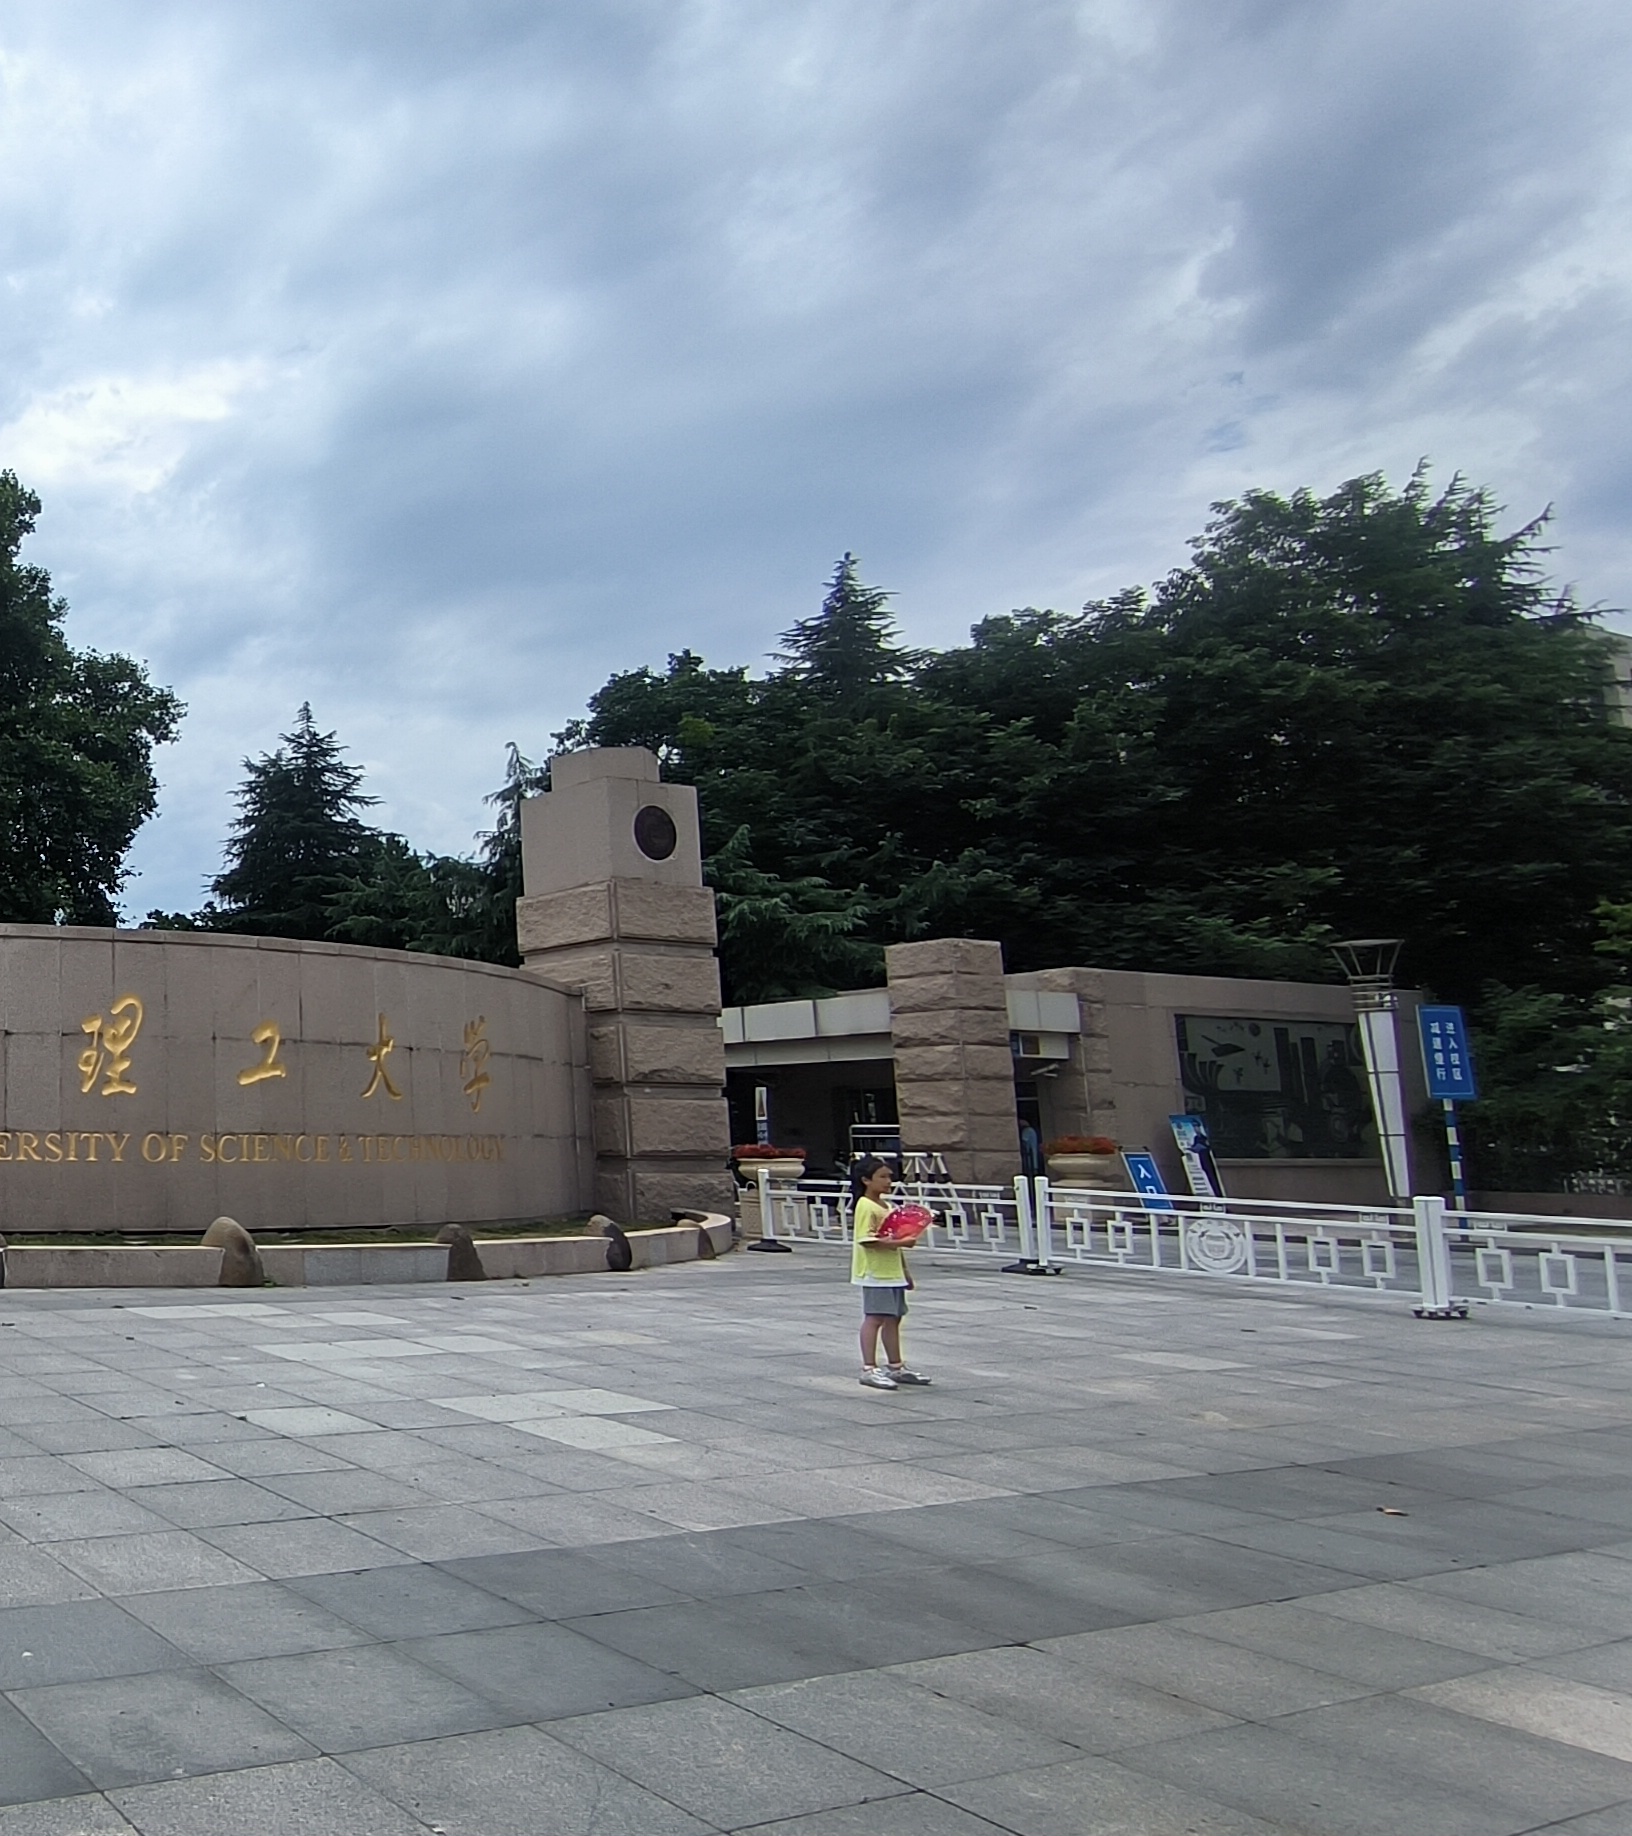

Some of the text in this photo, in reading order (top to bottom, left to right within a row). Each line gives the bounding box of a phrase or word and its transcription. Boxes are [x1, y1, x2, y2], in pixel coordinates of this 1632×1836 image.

[141, 1132, 188, 1162] OF
[199, 1133, 330, 1162] SCIENCE
[338, 1134, 354, 1162] &
[358, 1134, 505, 1163] TECHNOLOGY
